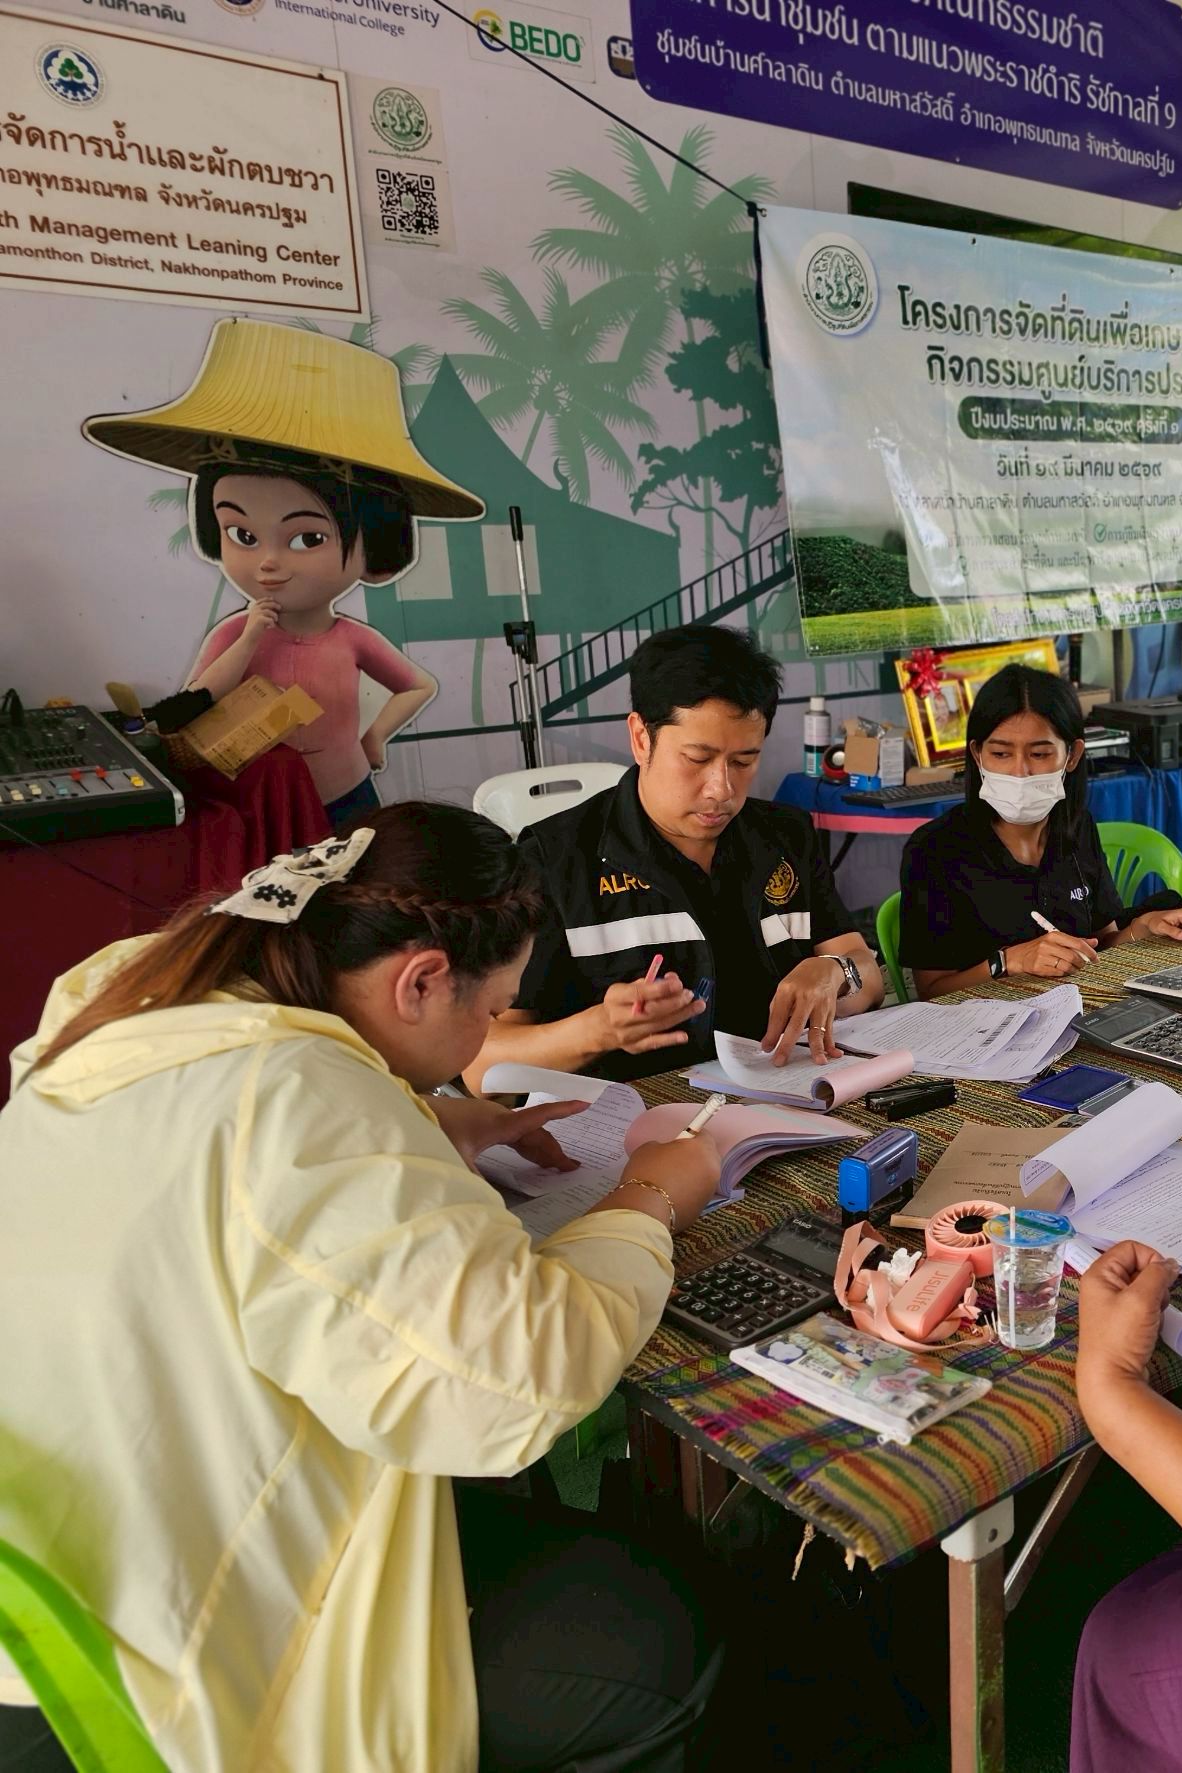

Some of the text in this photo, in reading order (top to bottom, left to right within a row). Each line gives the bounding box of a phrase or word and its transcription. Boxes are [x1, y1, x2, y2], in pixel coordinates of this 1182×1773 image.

[275, 0, 405, 37] International College
[509, 20, 581, 62] BEDO
[866, 22, 1081, 105] ตามแนวพระราชดำริ
[1086, 75, 1160, 126] รัชกาลที่
[1164, 102, 1177, 129] 9
[656, 29, 1174, 177] ชุมชนบ้านศาลาดิน ตำบลมหาสวัสดิ์ อำเภอพุทธมณฑล จังหวัดนครปฐม
[157, 182, 307, 228] จังหวัดนครปฐม
[30, 214, 177, 249] Management
[187, 232, 267, 263] Leaning
[276, 244, 340, 267] Center
[91, 251, 154, 273] District,
[161, 259, 276, 284] Nakhonpathom
[282, 273, 344, 292] Province
[970, 407, 1058, 431] ปีงบประมาณ
[996, 446, 1031, 477] วันที่
[1063, 455, 1114, 477] มีนาคม
